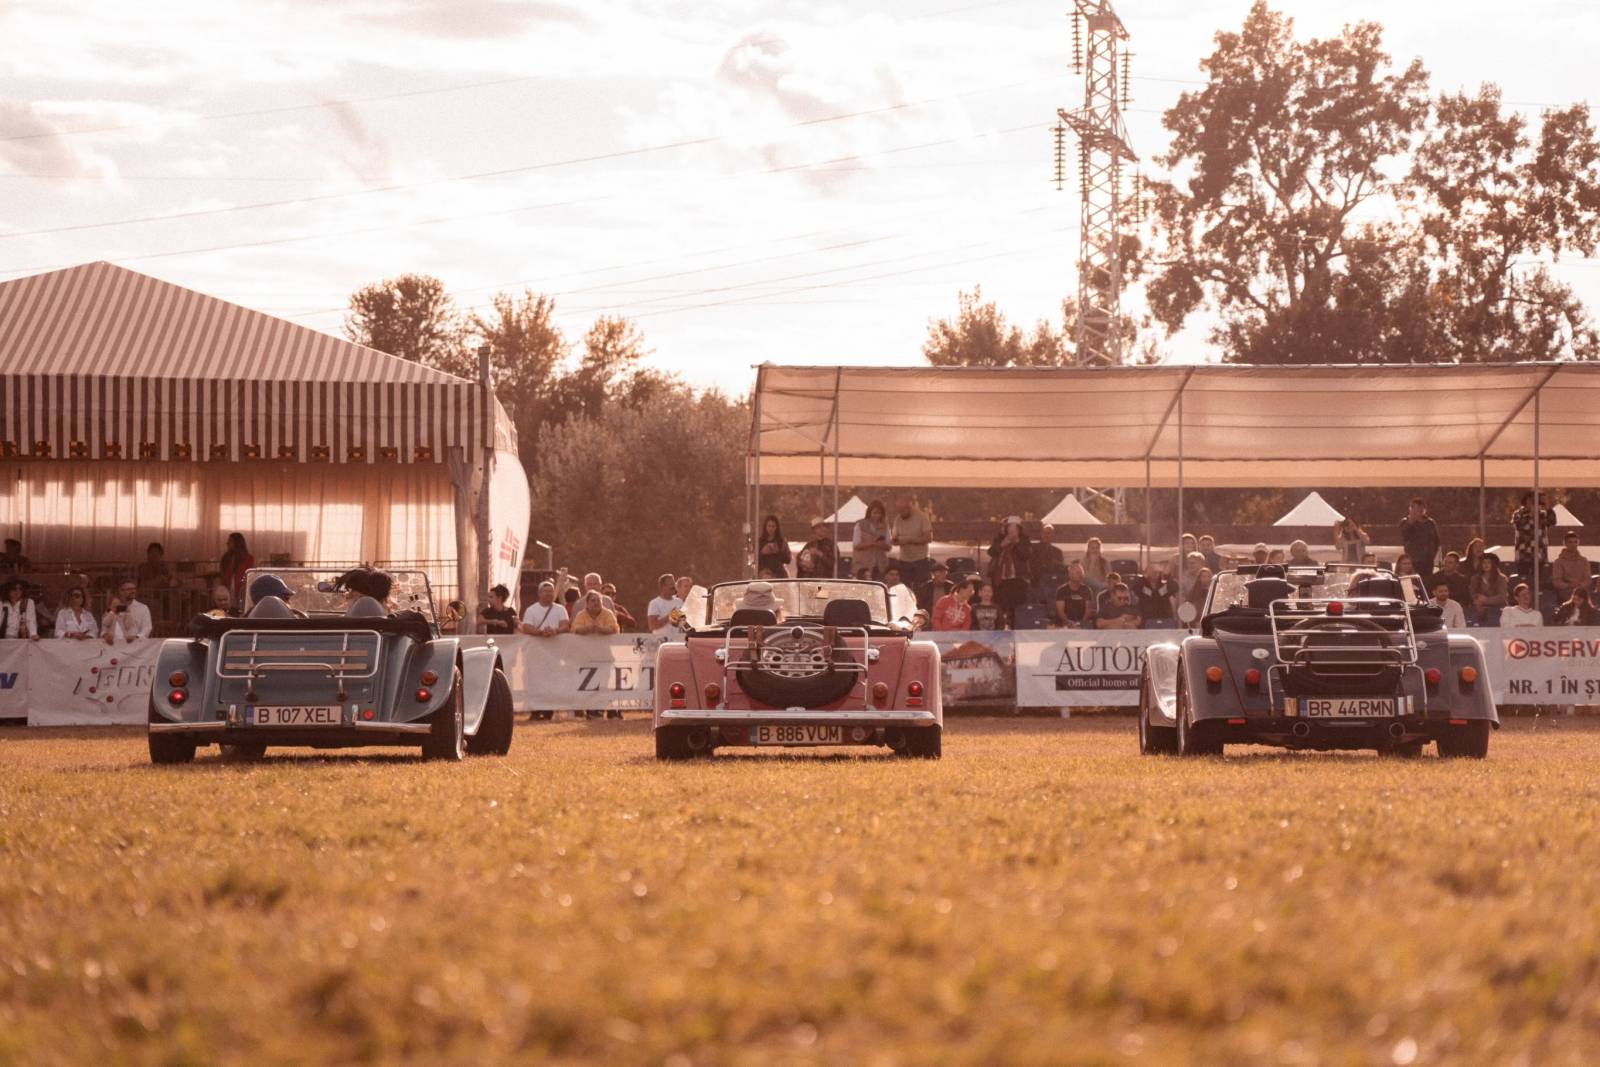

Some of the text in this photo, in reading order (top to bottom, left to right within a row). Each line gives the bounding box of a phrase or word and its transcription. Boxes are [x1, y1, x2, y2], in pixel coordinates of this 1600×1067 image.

[1067, 679, 1139, 688] Official home of
[1509, 679, 1538, 695] NR.
[1545, 679, 1553, 695] 1
[1561, 675, 1578, 695] ÎN
[258, 708, 270, 724] B
[1309, 701, 1332, 716] BR
[760, 727, 770, 742] B
